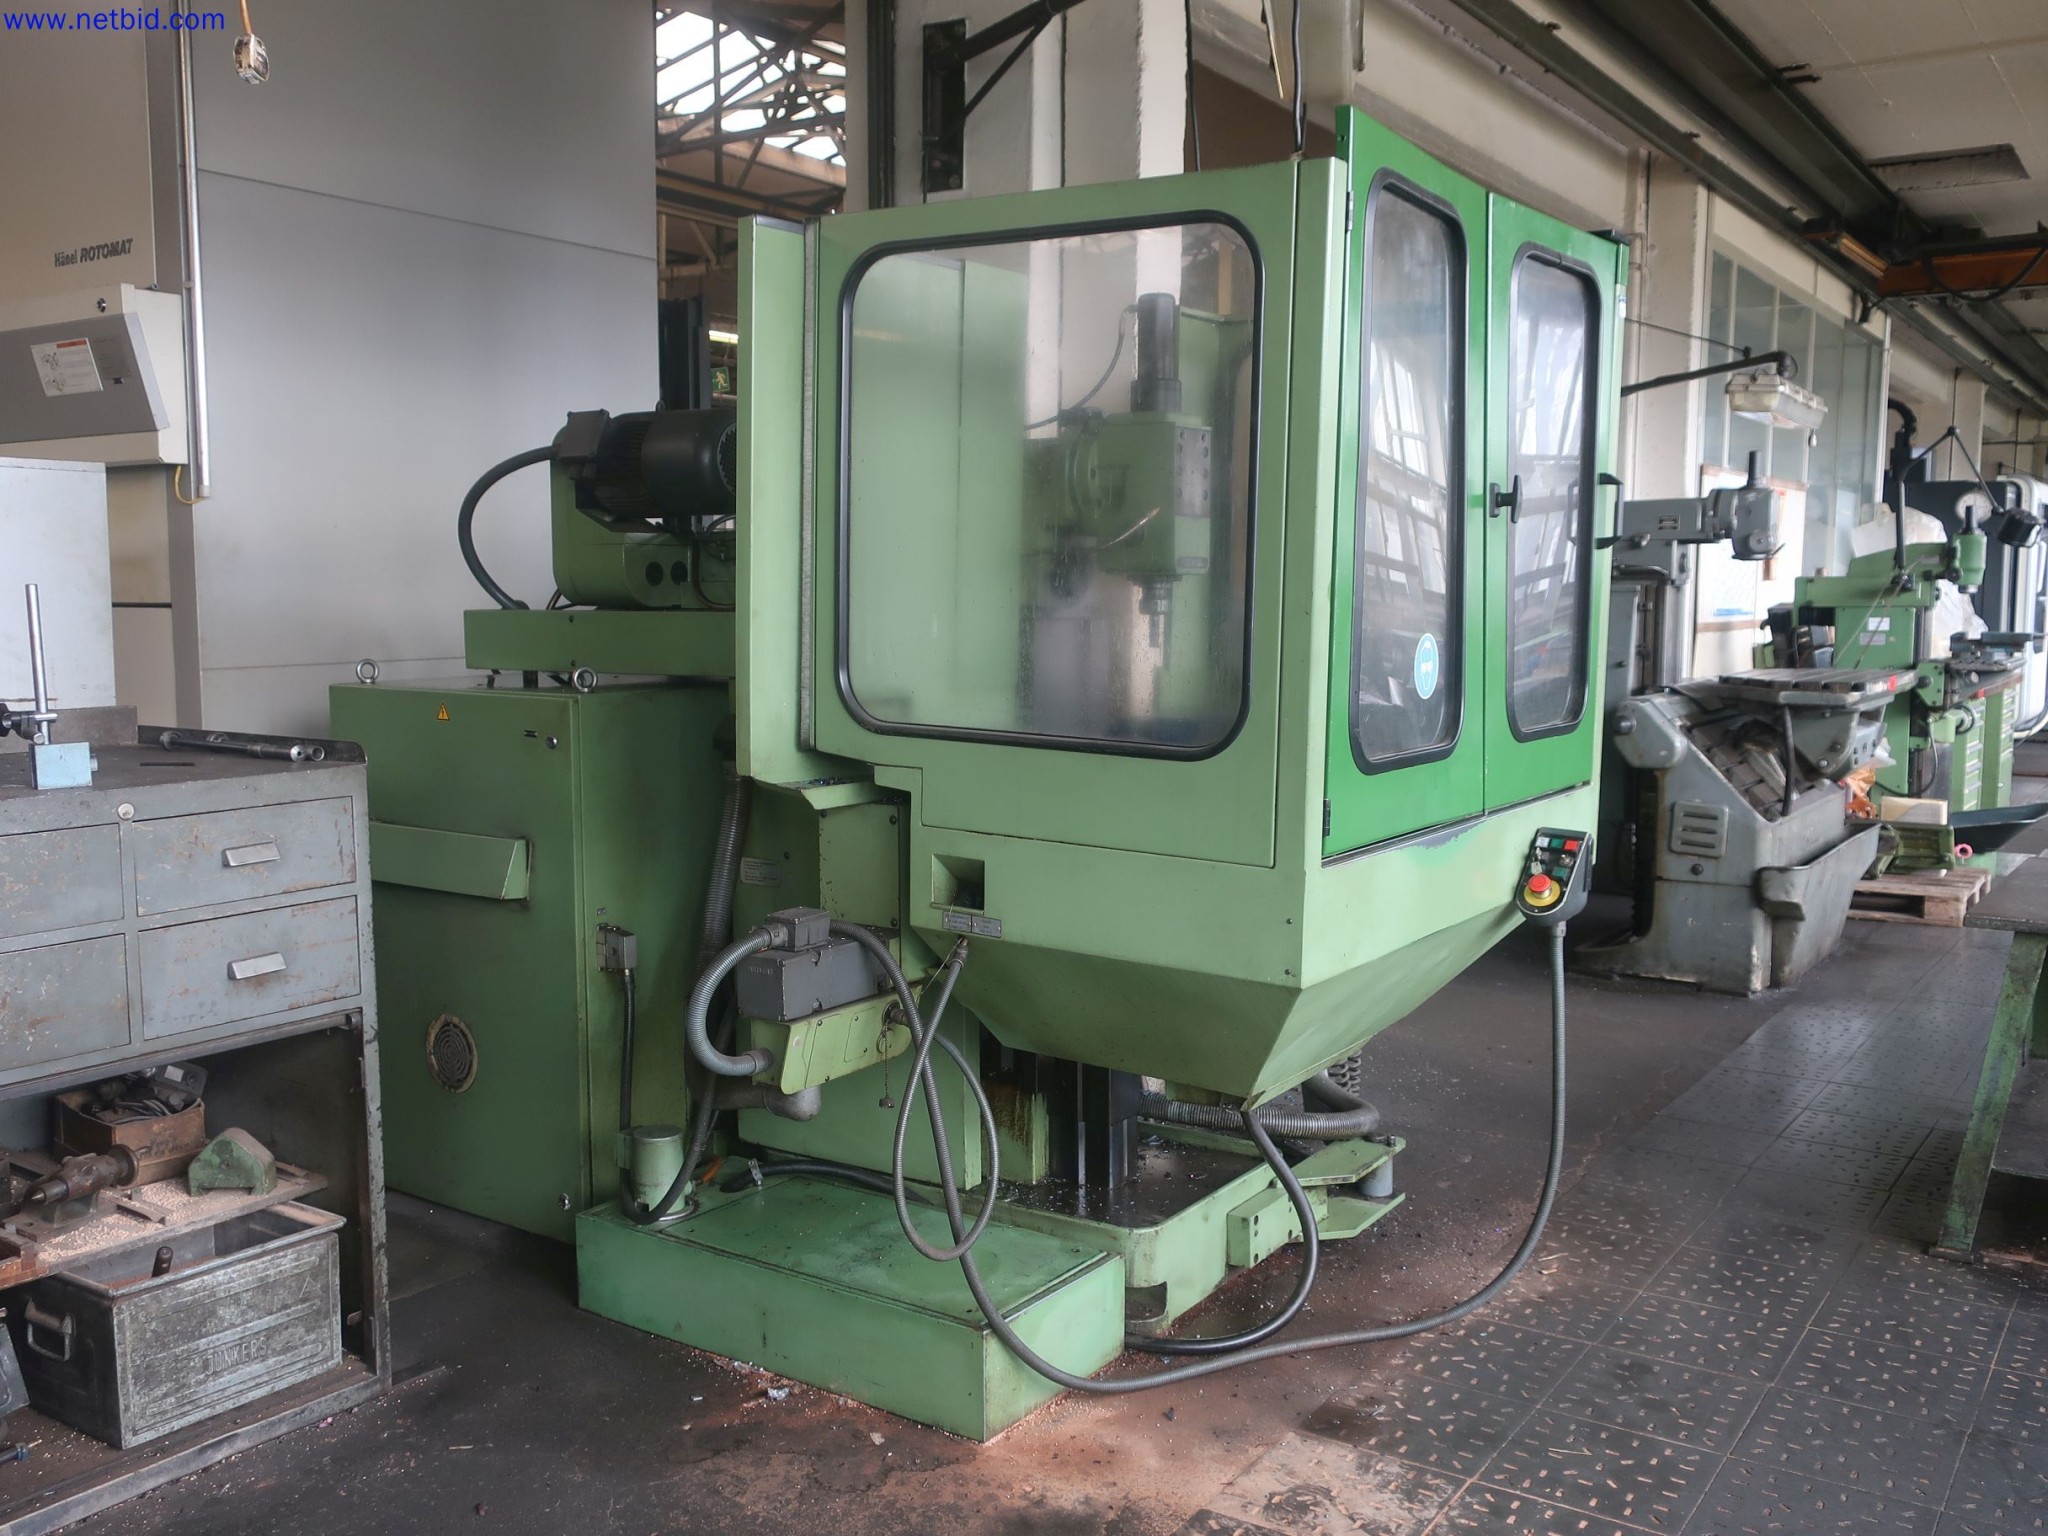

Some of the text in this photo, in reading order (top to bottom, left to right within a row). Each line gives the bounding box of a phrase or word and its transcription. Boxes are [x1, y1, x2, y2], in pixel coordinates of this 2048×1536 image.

[54, 238, 133, 267] Hänel ROTOMAT
[205, 1337, 267, 1375] JUNKERS
